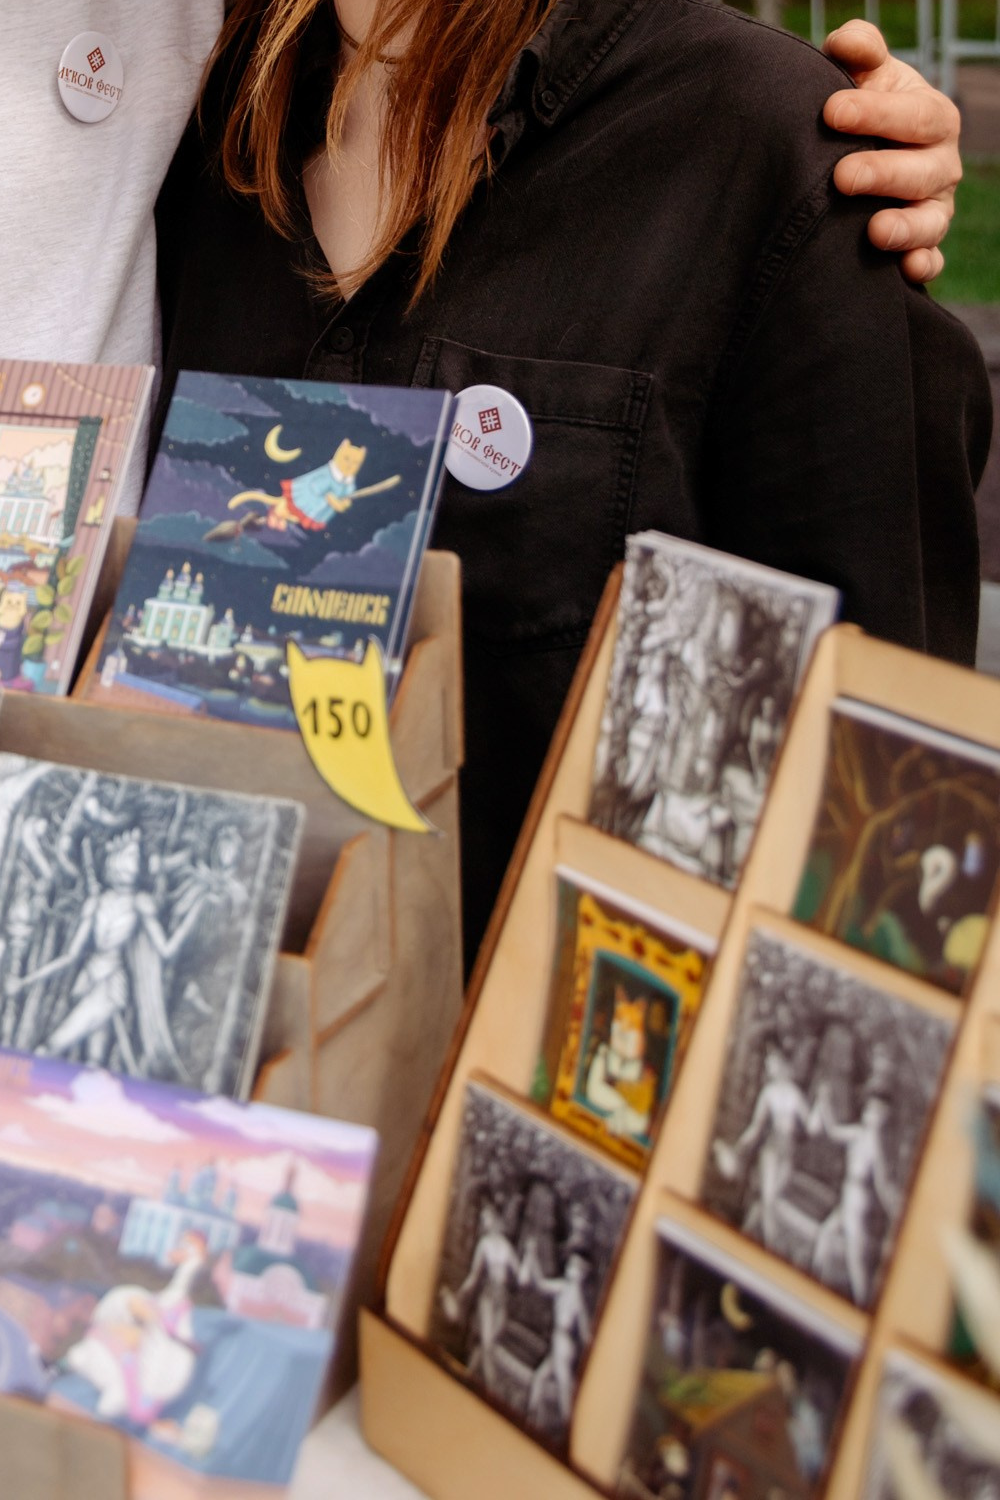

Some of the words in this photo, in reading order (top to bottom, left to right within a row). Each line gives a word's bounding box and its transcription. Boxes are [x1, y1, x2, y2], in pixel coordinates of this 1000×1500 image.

[96, 79, 123, 101] ФЕСТ
[451, 423, 481, 451] КОВ
[483, 444, 521, 477] ФЕСТ
[302, 696, 372, 740] 150
